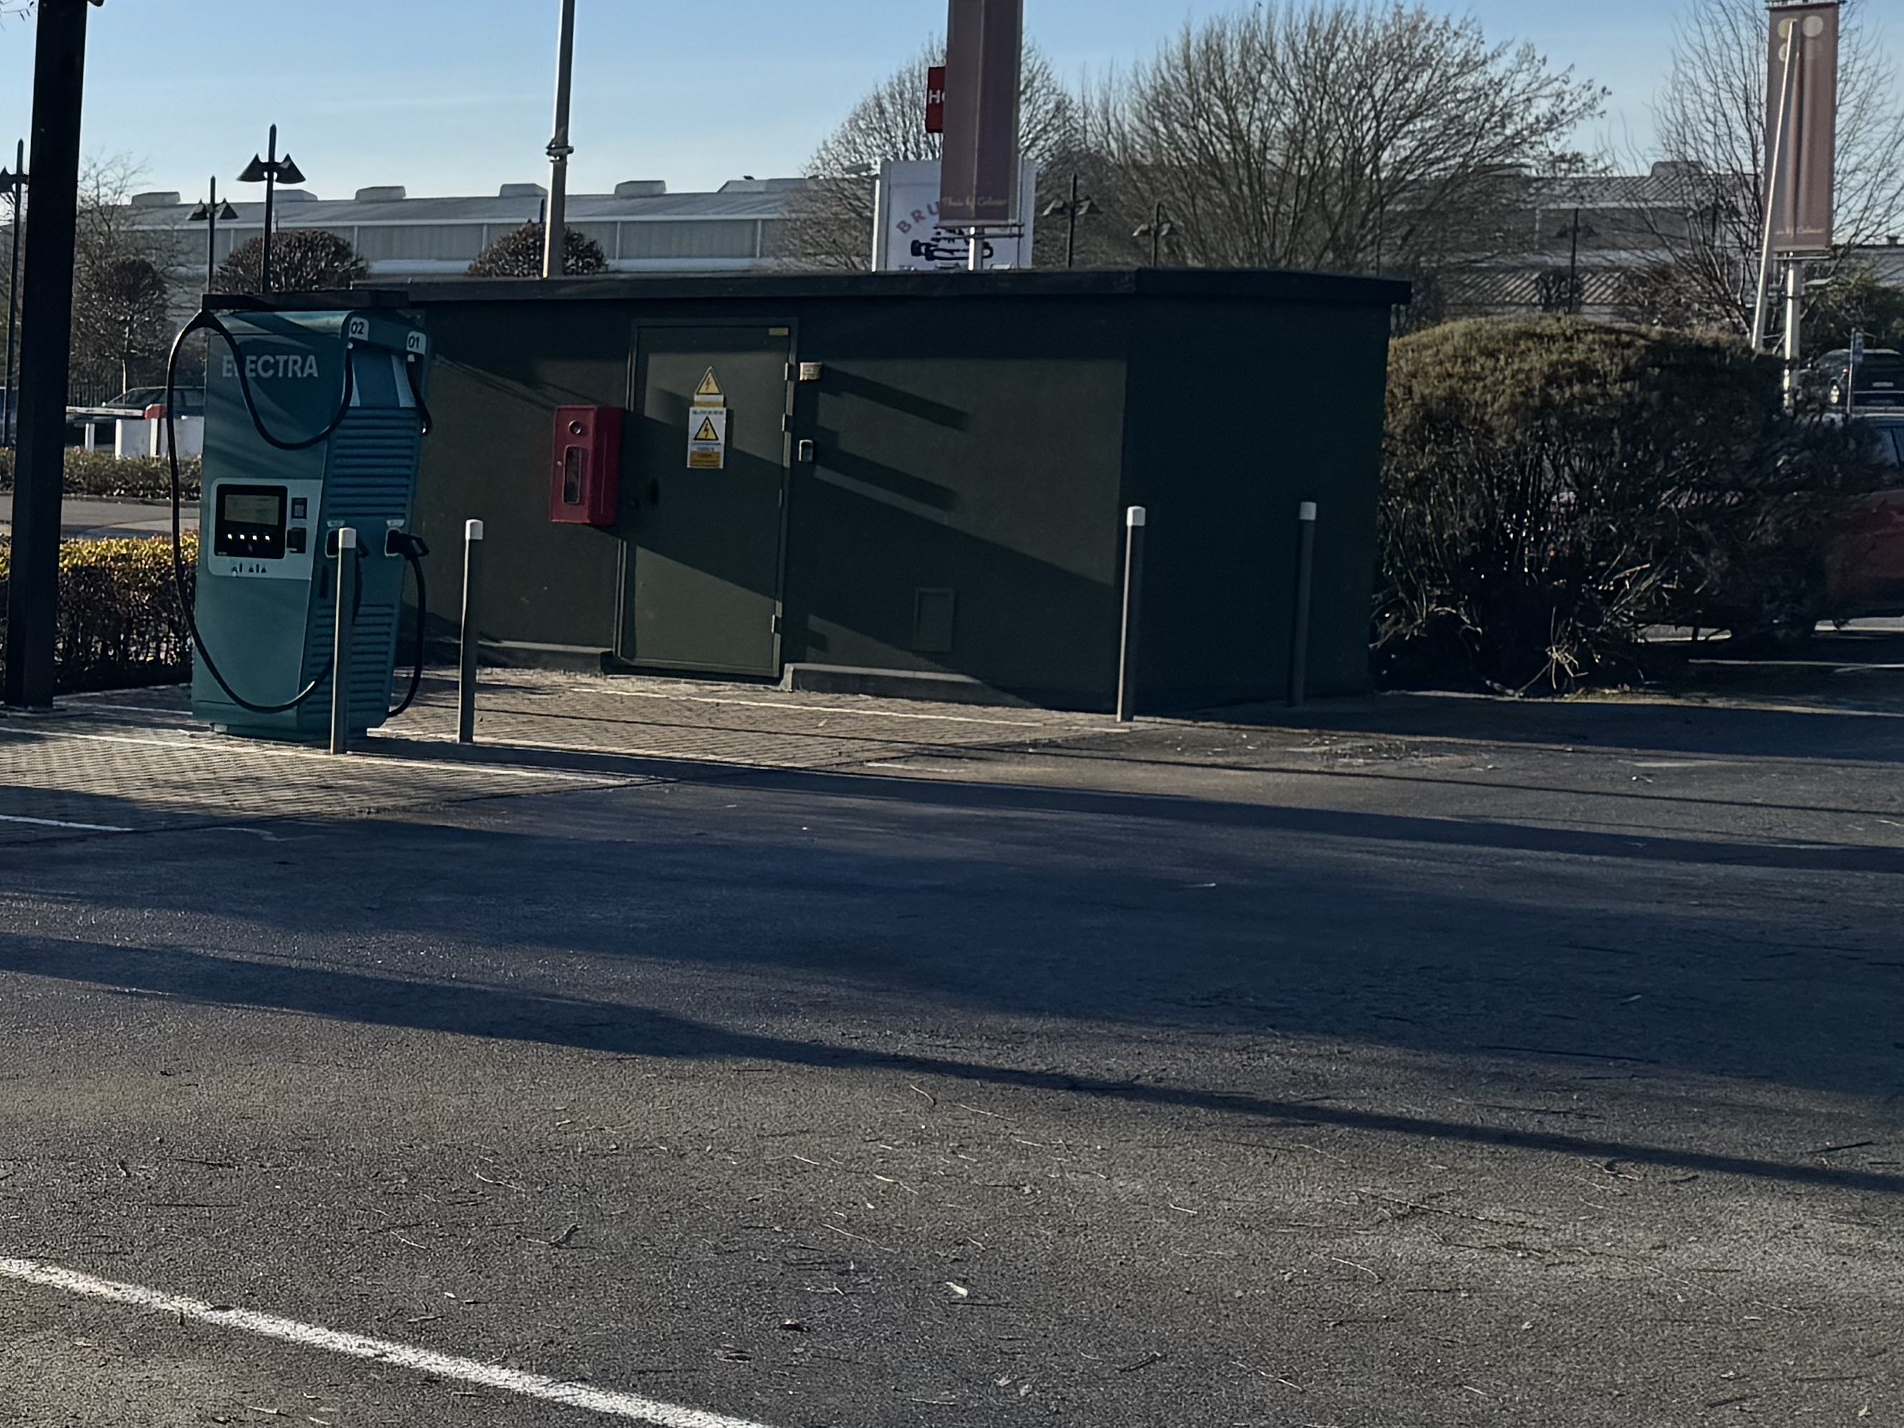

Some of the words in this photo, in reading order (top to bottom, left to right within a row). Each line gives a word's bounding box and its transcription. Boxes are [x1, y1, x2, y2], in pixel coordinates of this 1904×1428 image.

[350, 321, 365, 335] 02
[407, 335, 420, 349] 01
[222, 355, 319, 378] EECTRA
